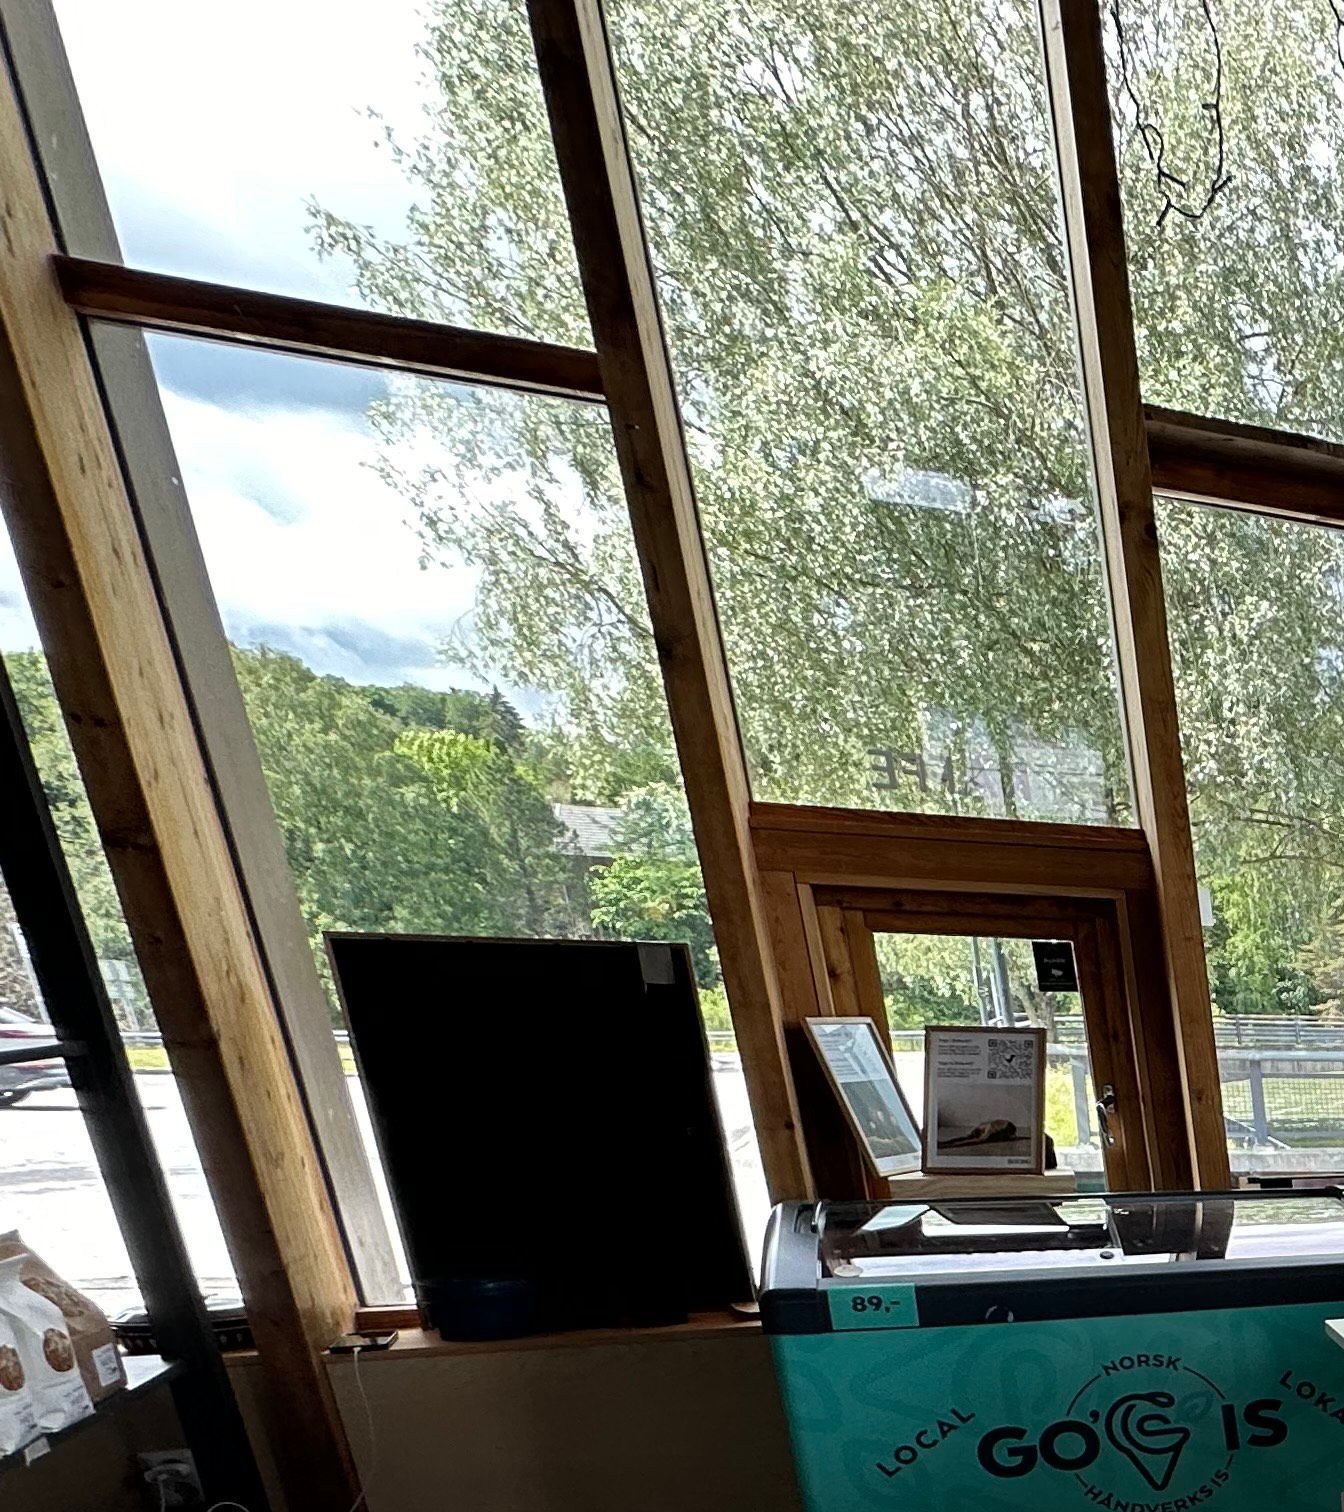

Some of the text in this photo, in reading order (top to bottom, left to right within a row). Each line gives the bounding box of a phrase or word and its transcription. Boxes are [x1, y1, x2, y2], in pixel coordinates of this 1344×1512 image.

[851, 1295, 900, 1313] 89,-
[1103, 1354, 1182, 1376] NORSK
[875, 1408, 976, 1478] LOCAL
